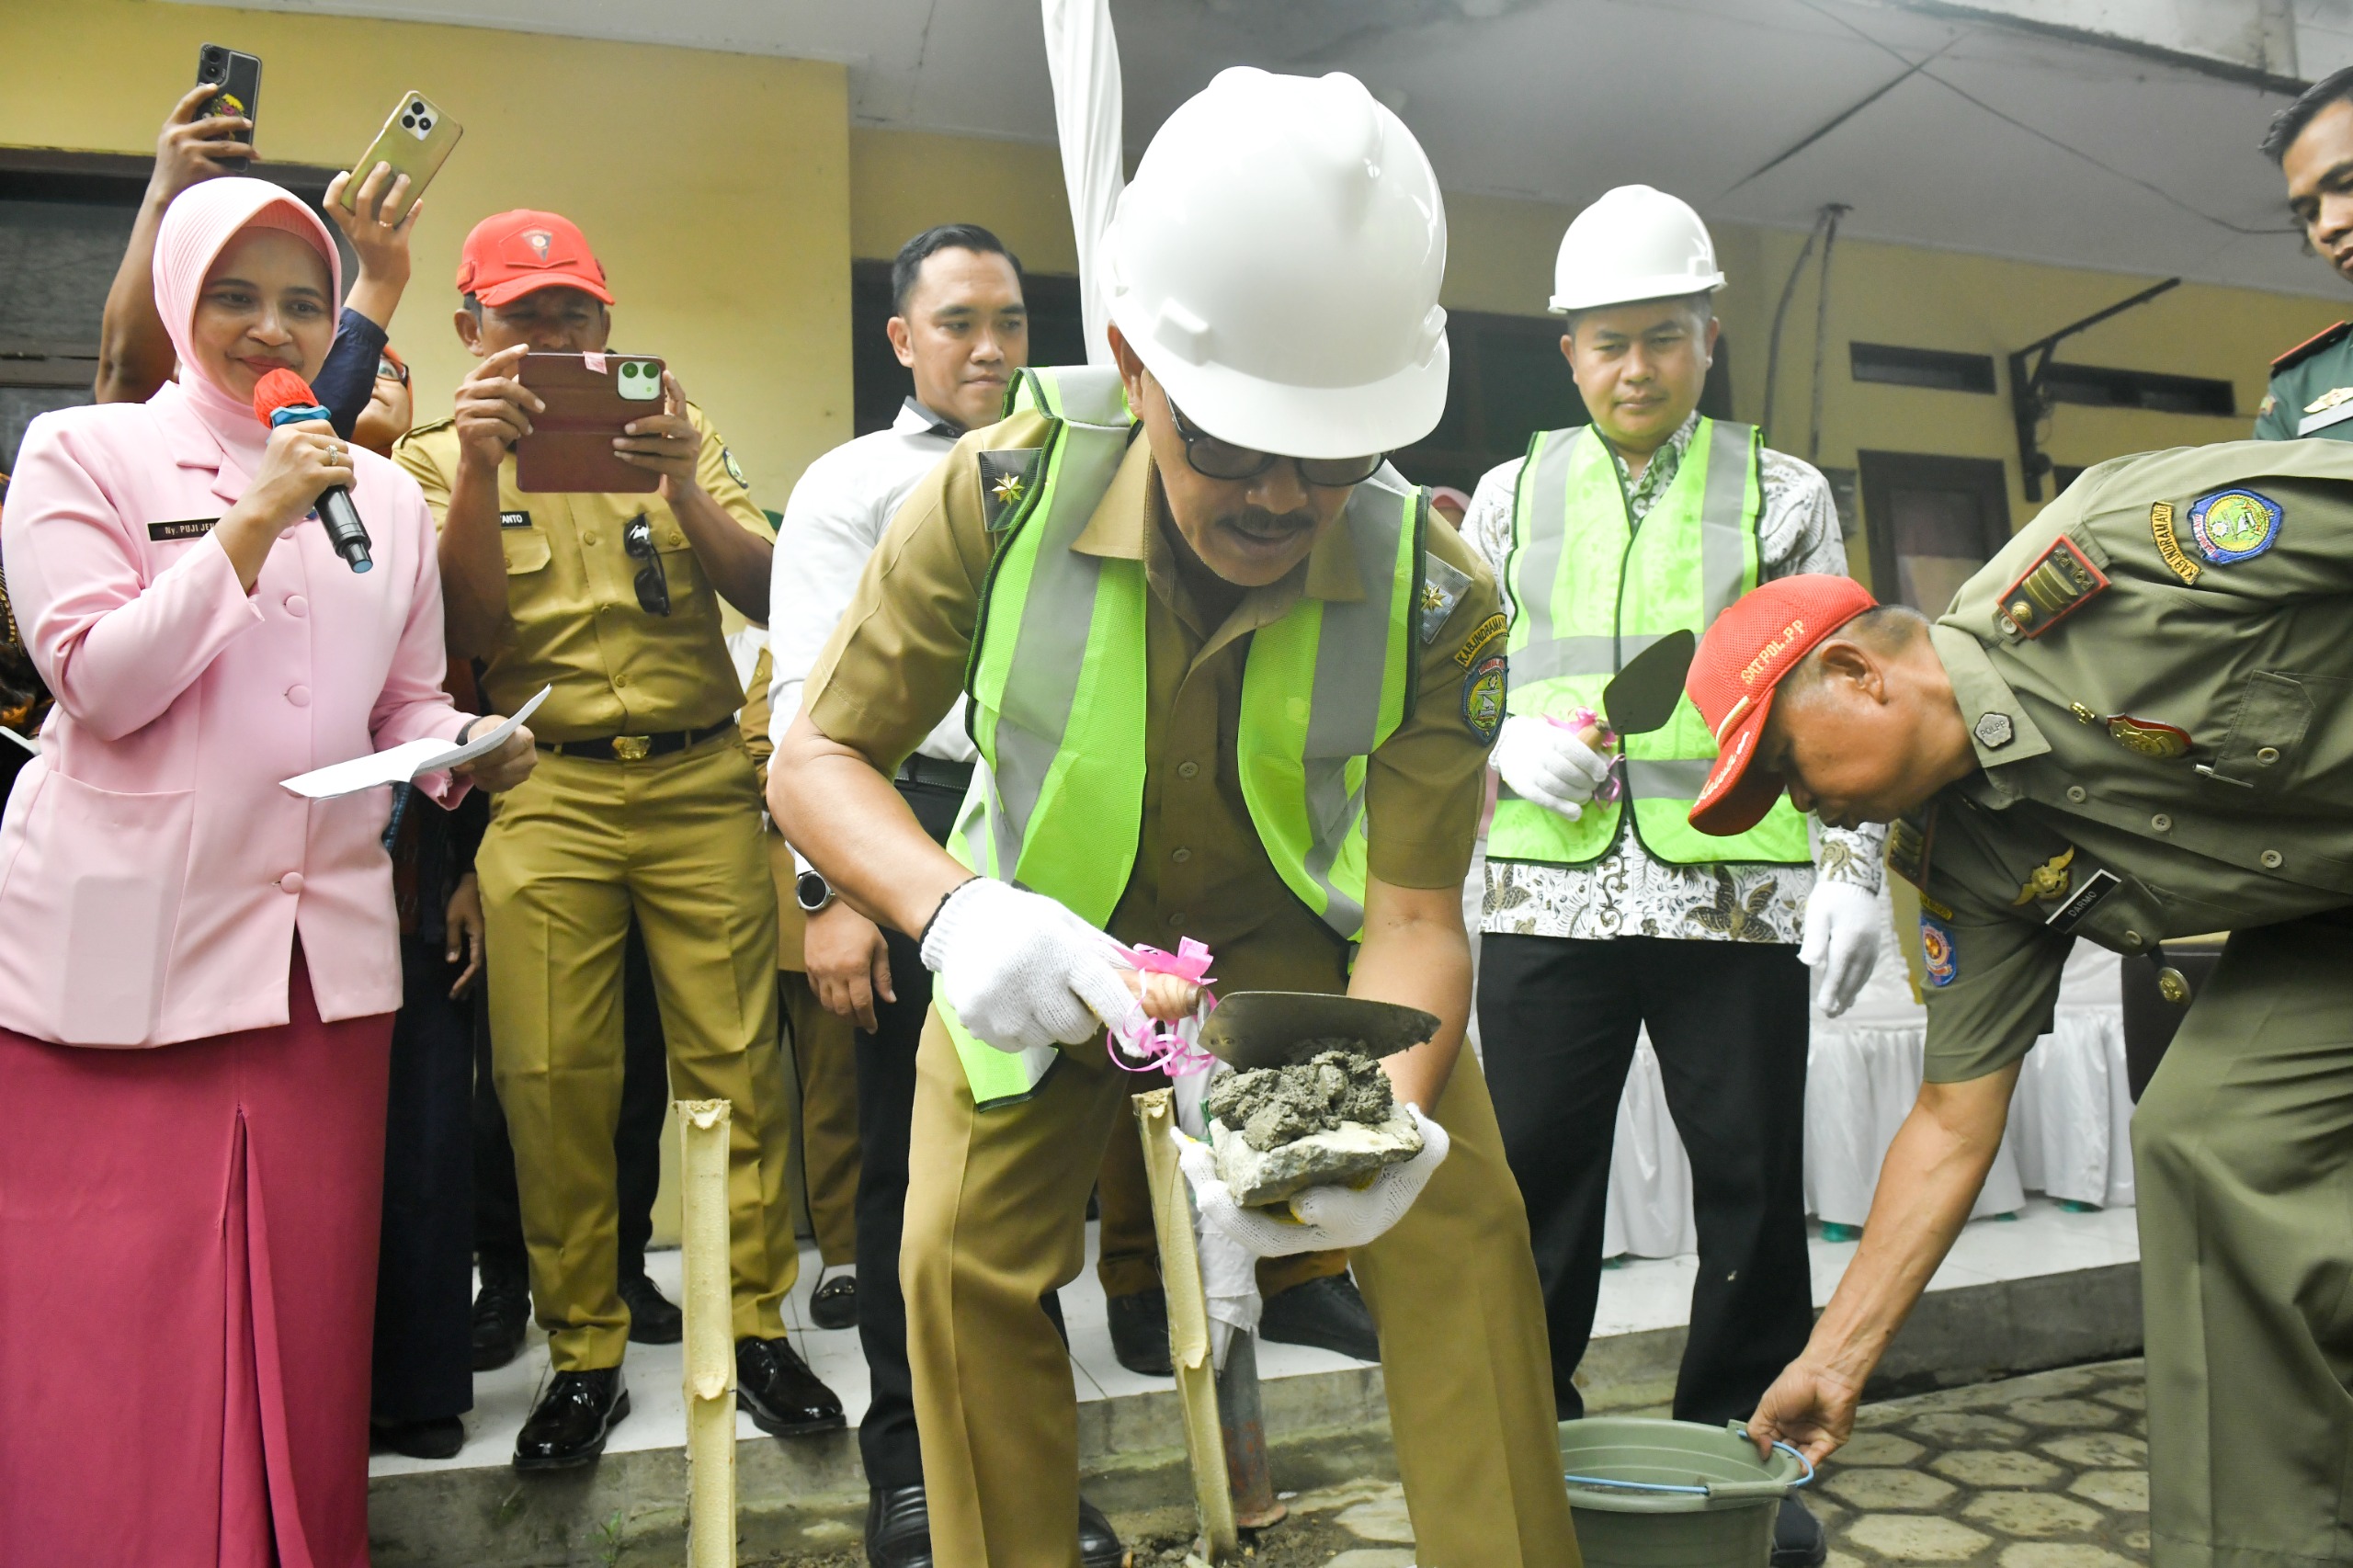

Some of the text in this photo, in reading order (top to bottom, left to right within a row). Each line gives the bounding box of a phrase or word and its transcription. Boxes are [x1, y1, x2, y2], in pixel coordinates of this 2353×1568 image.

[500, 514, 523, 524] ANTO
[165, 526, 178, 536] Ny.
[179, 524, 199, 533] PUJI
[2067, 890, 2097, 918] DARMO
